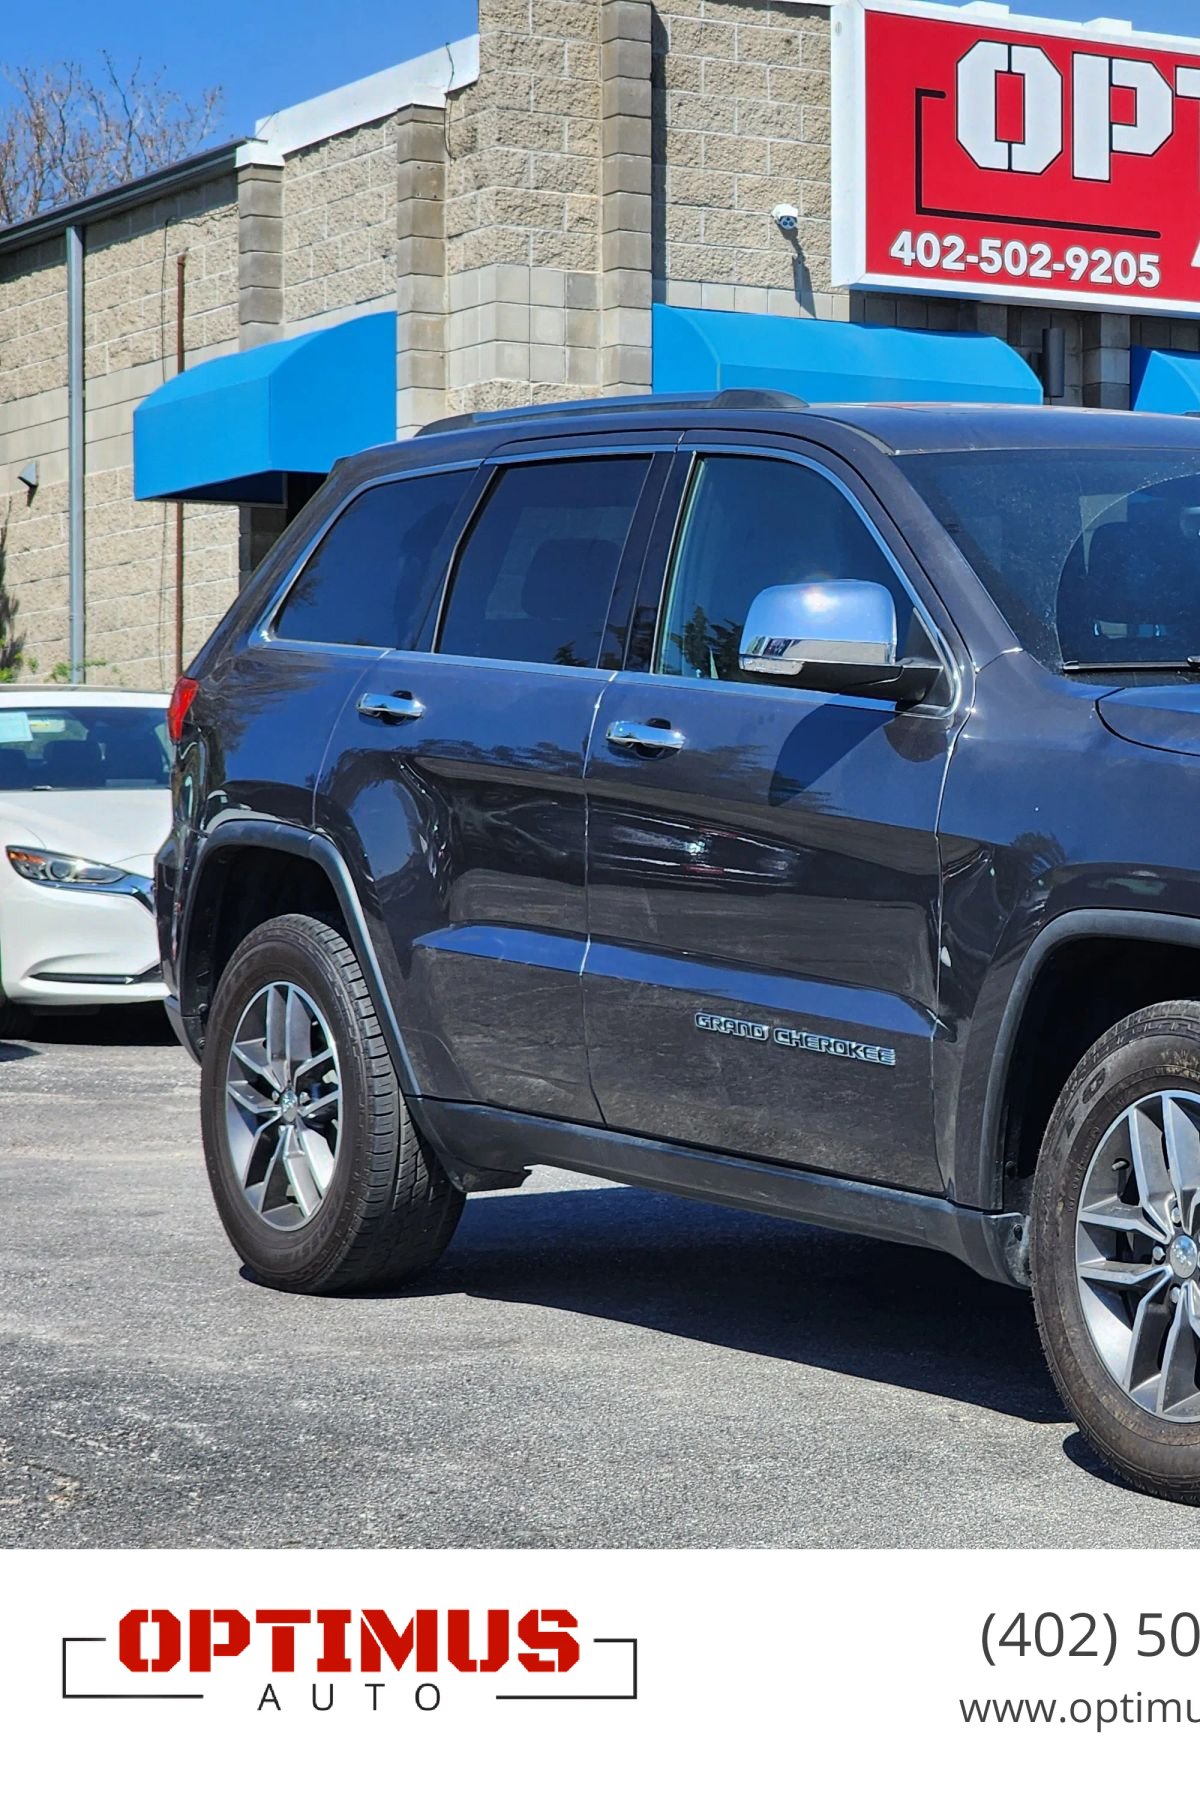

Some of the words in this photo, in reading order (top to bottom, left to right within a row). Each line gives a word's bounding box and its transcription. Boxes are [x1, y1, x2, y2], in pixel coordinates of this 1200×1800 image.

[889, 231, 1162, 289] 402-502-9205
[694, 1012, 770, 1041] GRAND
[773, 1028, 897, 1067] CHEROKEE
